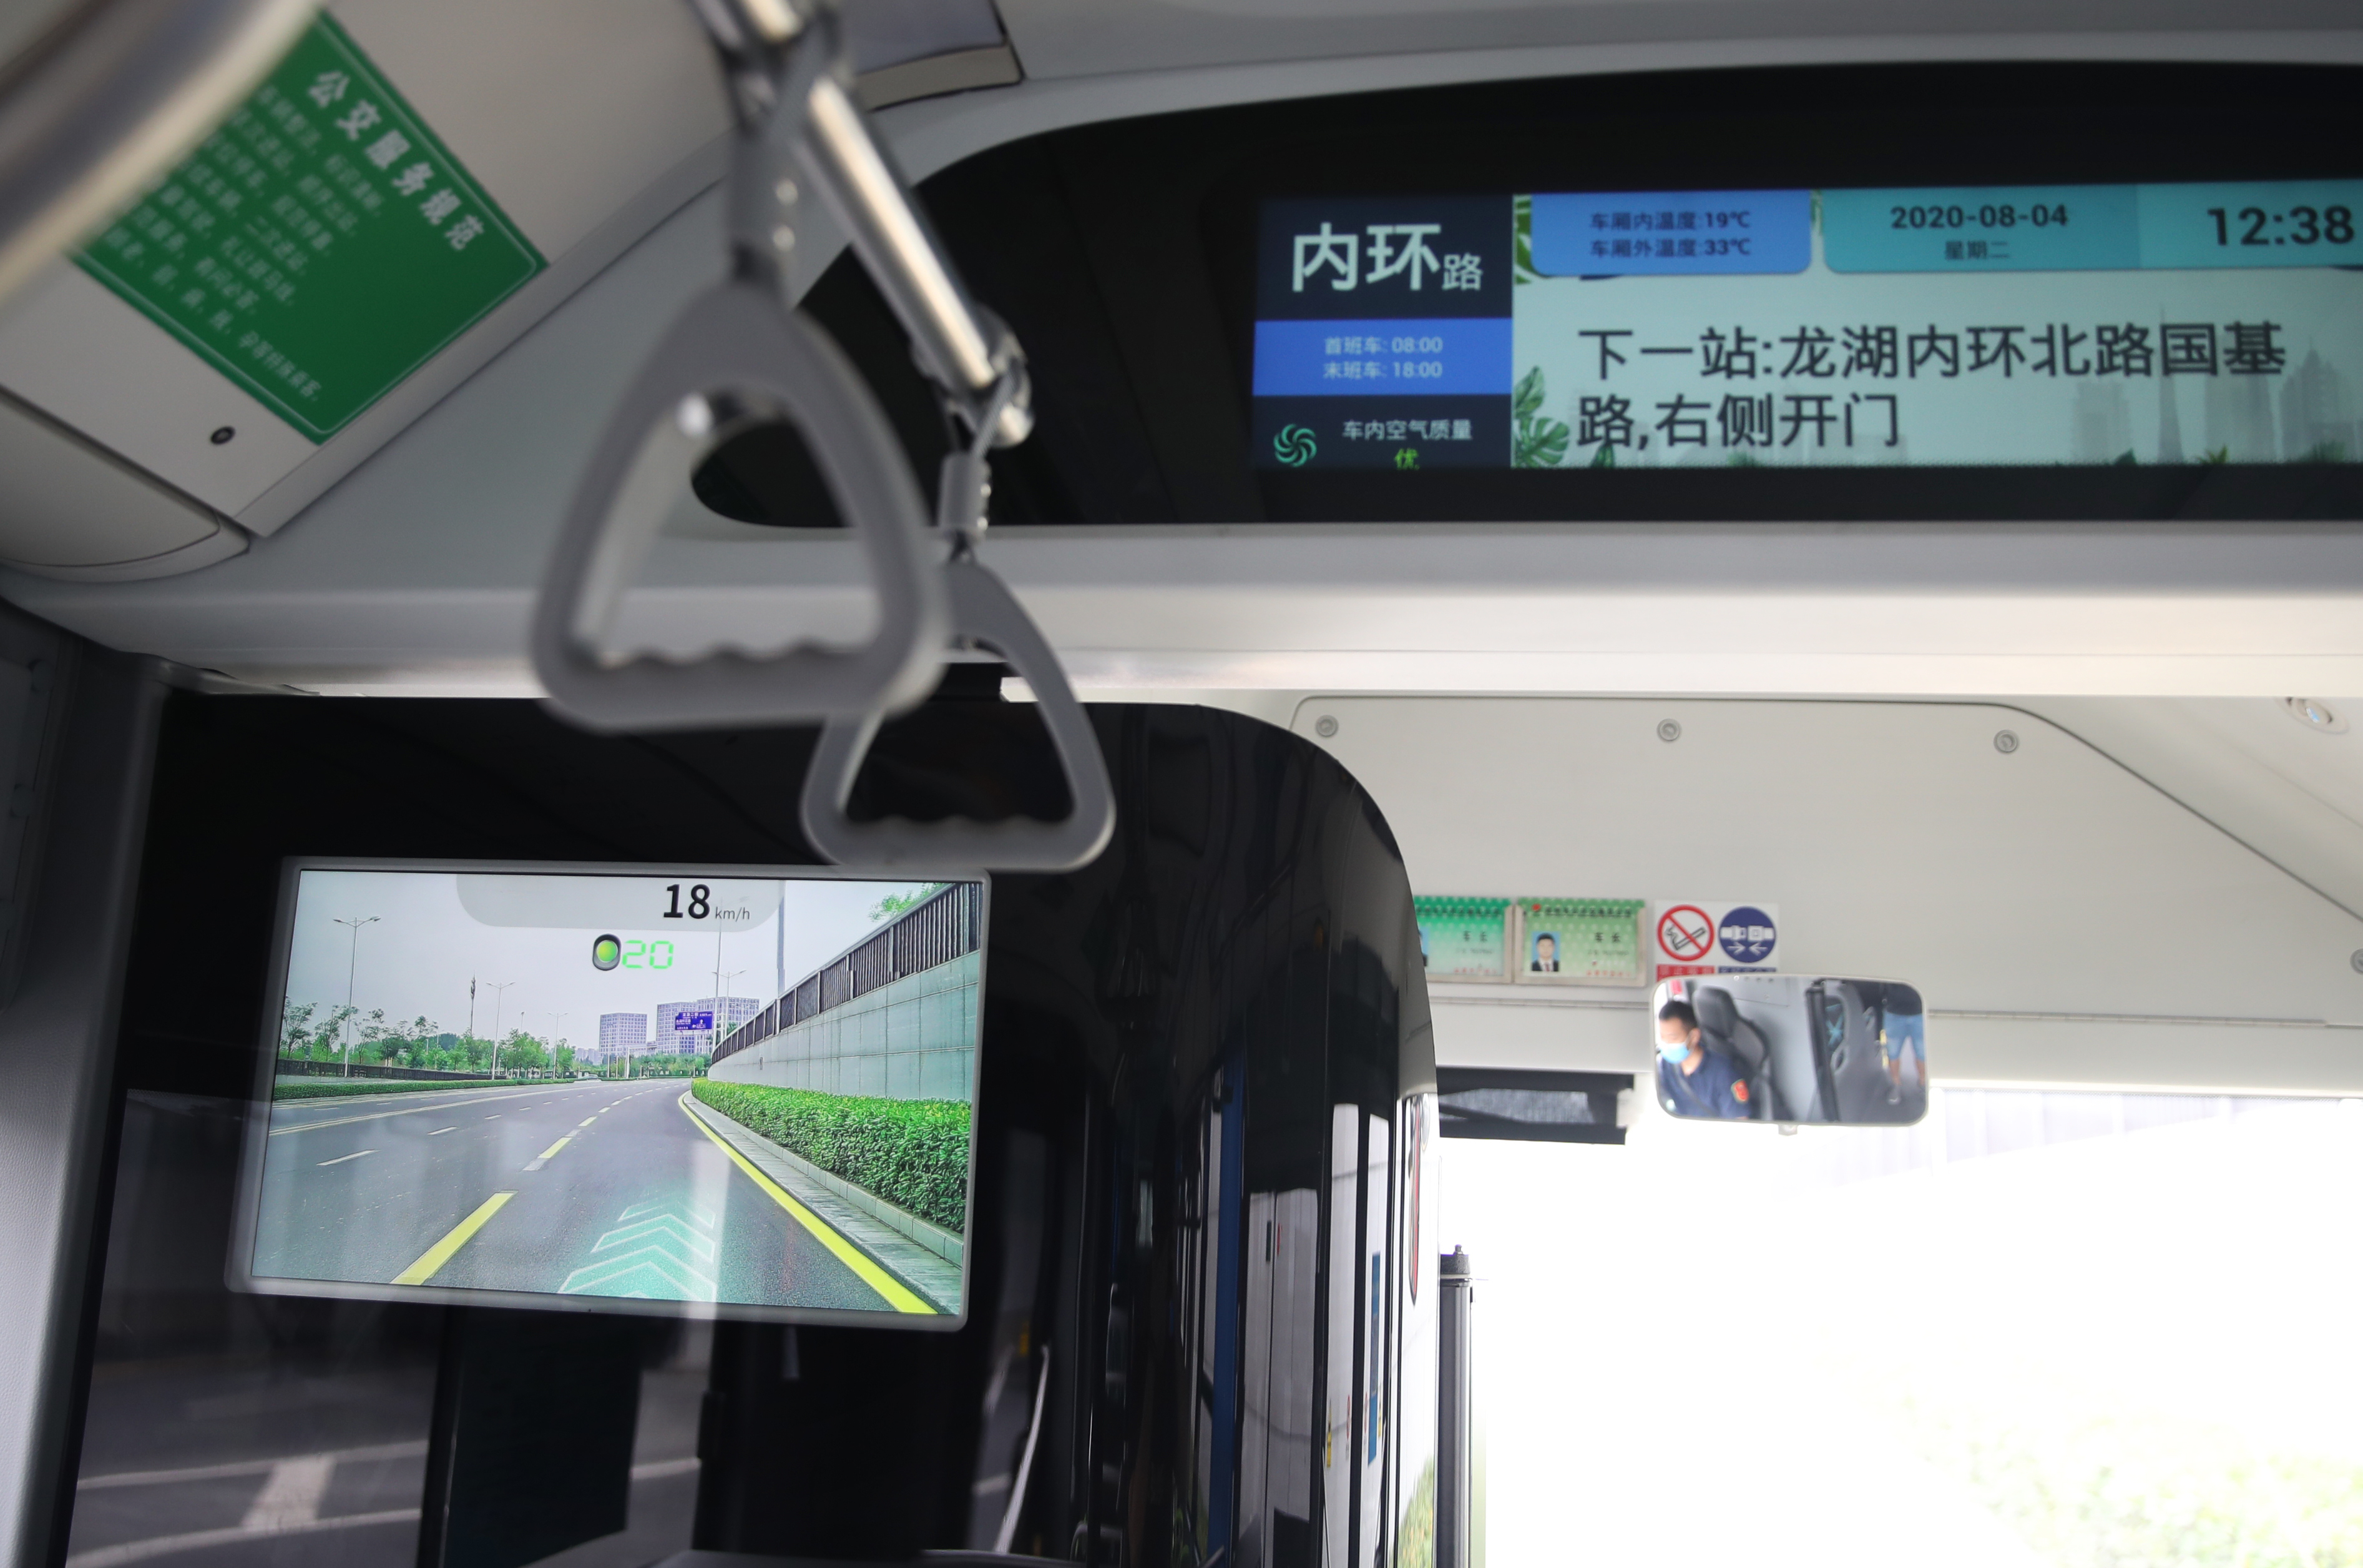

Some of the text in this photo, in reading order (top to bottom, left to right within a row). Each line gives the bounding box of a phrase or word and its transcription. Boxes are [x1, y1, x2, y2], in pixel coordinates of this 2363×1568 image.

[308, 70, 484, 251] 公交服务规范
[1891, 204, 2068, 229] 2020-08-04
[2207, 205, 2354, 247] 12:38
[1293, 223, 1484, 292] 内环路
[1945, 240, 2010, 260] 星期二
[1391, 336, 1443, 354] 08:00
[1578, 321, 2286, 380] 下一站:龙湖内环北路国基
[1394, 361, 1443, 378] 18:00
[1343, 418, 1472, 441] 车内空气质量
[1577, 392, 1899, 451] 路,右侧开门
[1394, 447, 1419, 470] 优
[662, 883, 750, 921] 18 km/h
[622, 939, 674, 970] 20
